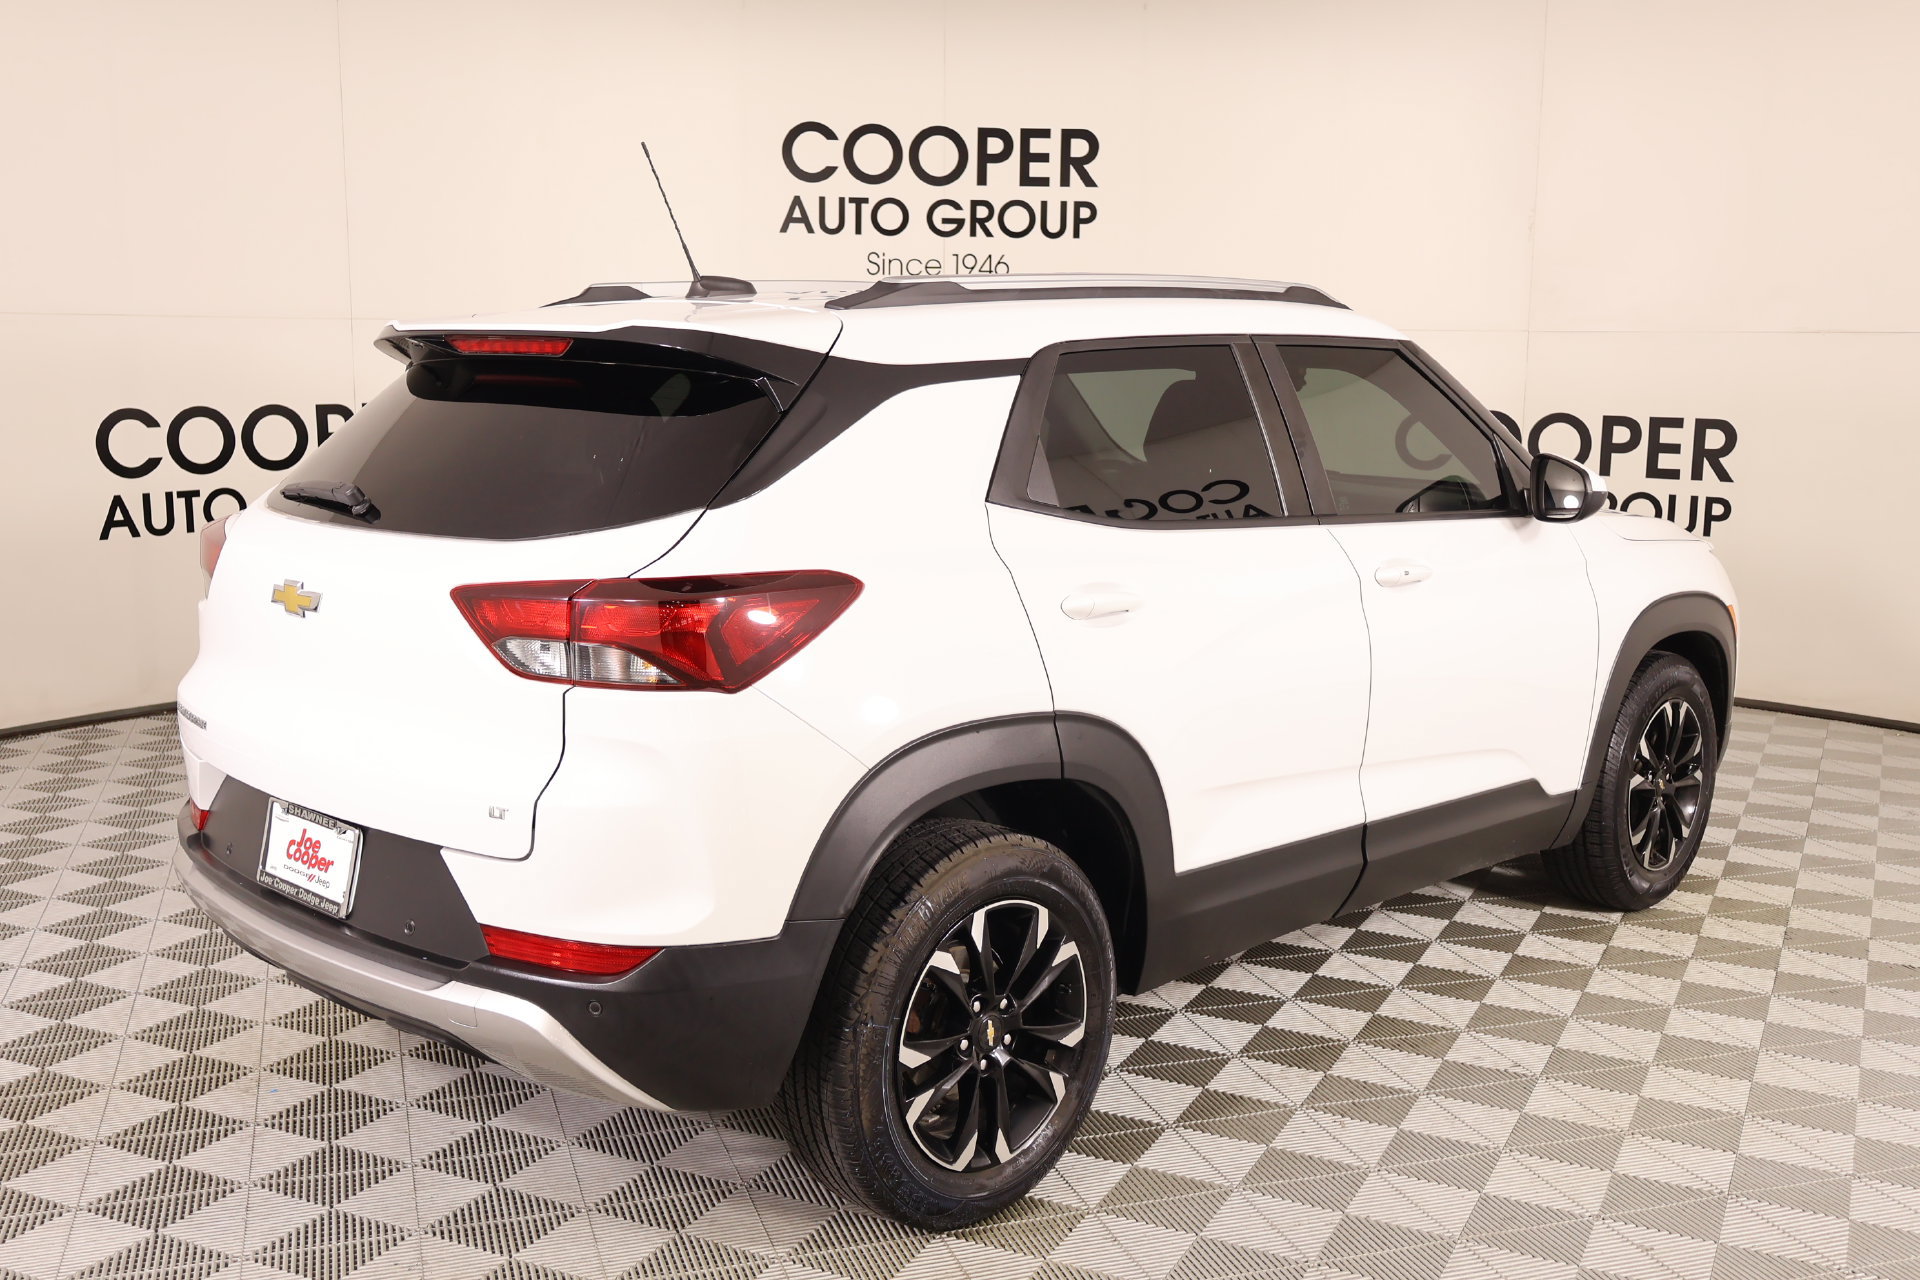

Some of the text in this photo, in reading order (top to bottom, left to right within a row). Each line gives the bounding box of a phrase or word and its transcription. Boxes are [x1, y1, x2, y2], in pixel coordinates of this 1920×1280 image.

[782, 121, 1100, 188] COOPER
[779, 195, 1098, 239] AUTO GROUP
[866, 251, 1010, 276] Since 1946
[288, 804, 335, 830] SHAWNEE
[296, 828, 321, 853] Joe
[286, 839, 334, 873] Cooper
[260, 872, 338, 915] Joe Cooper Dodge Jeep
[315, 875, 330, 889] Jeep
